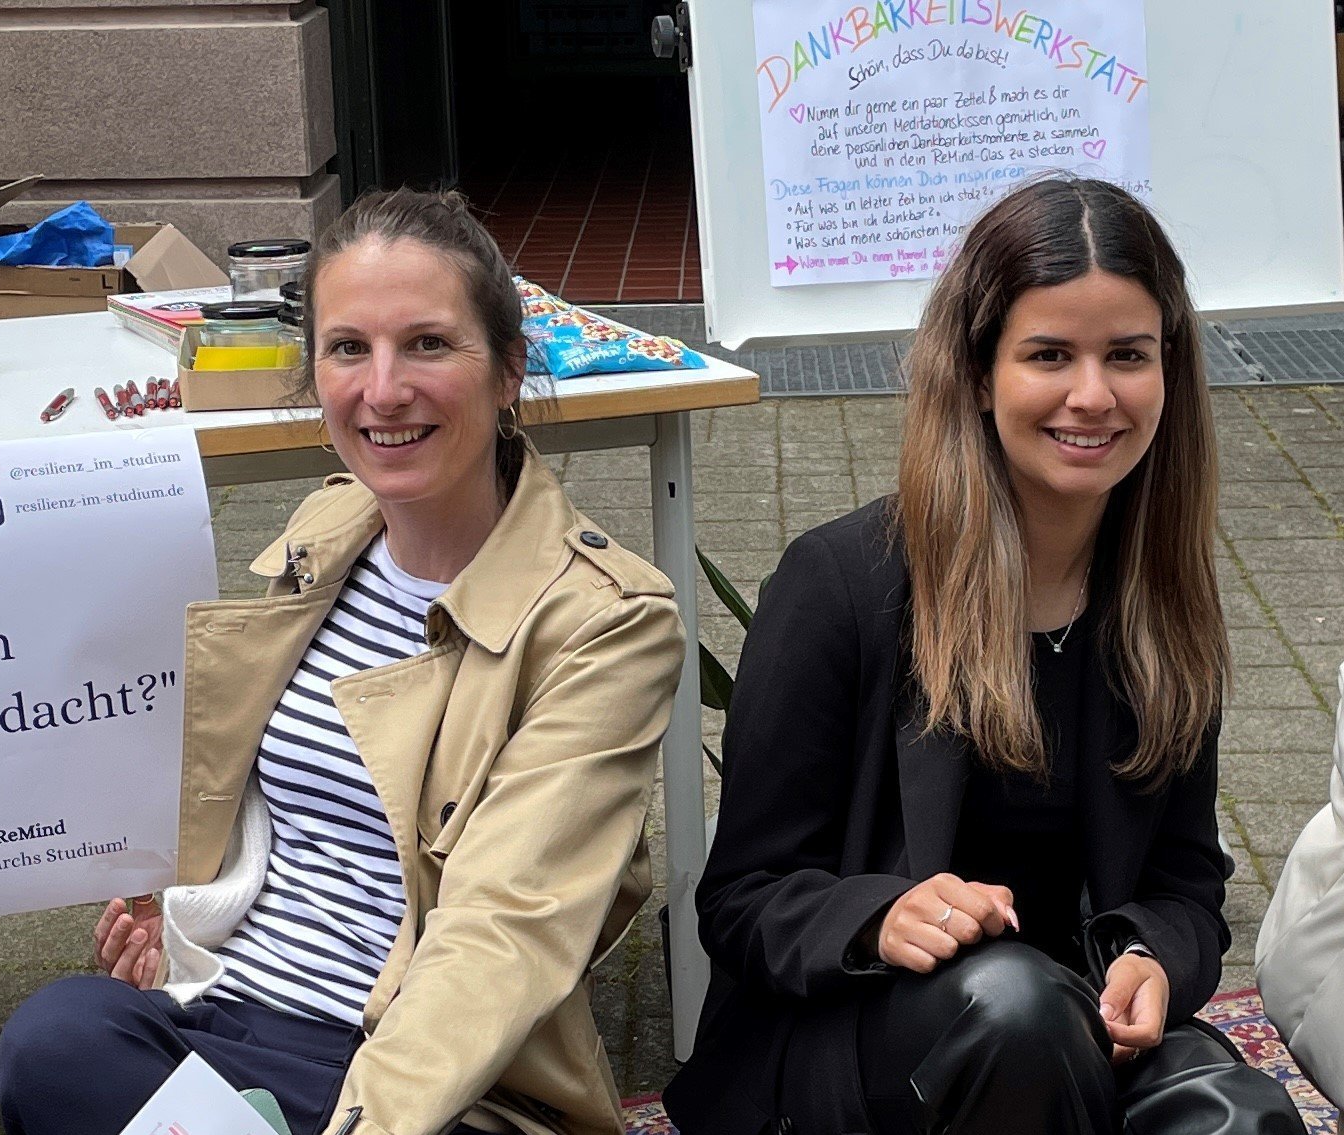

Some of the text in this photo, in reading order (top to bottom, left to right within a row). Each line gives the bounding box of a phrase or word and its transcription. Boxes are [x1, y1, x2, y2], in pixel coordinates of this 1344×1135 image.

[848, 59, 889, 91] Schön,
[892, 44, 924, 69] dass
[927, 38, 952, 61] Du
[807, 106, 839, 123] Nimm
[845, 100, 861, 117] dir
[866, 100, 901, 124] gerne
[902, 99, 919, 112] ein
[923, 97, 948, 114] paar
[954, 91, 986, 109] Zettel
[1001, 86, 1029, 102] mach
[1034, 89, 1048, 100] es
[1053, 85, 1070, 100] dir
[818, 107, 1081, 141] auf unseren Meditationskissen gemütlich, um
[811, 125, 1100, 160] deine persönlichen Dankbarkeitsmomente zu sammeln
[855, 144, 1075, 169] und in dein ReMind-Glas zu stecken
[770, 166, 1026, 200] Diese Fragen können Dich inspirieren
[794, 199, 814, 218] Auf
[819, 203, 839, 215] was
[845, 200, 857, 211] in
[860, 195, 893, 210] letzter
[919, 193, 935, 205] bin
[939, 192, 955, 203] ich
[794, 220, 814, 233] Für
[818, 220, 838, 231] was
[842, 218, 859, 229] bin
[864, 213, 878, 227] ich
[795, 236, 817, 250] Was
[821, 233, 846, 248] sind
[885, 224, 939, 242] schönsten
[852, 250, 868, 265] Du
[101, 274, 114, 290] L
[10, 452, 181, 481] @resilienz_im_studium
[15, 484, 185, 514] resilienz-im-studium.de
[46, 836, 130, 862] Studium!
